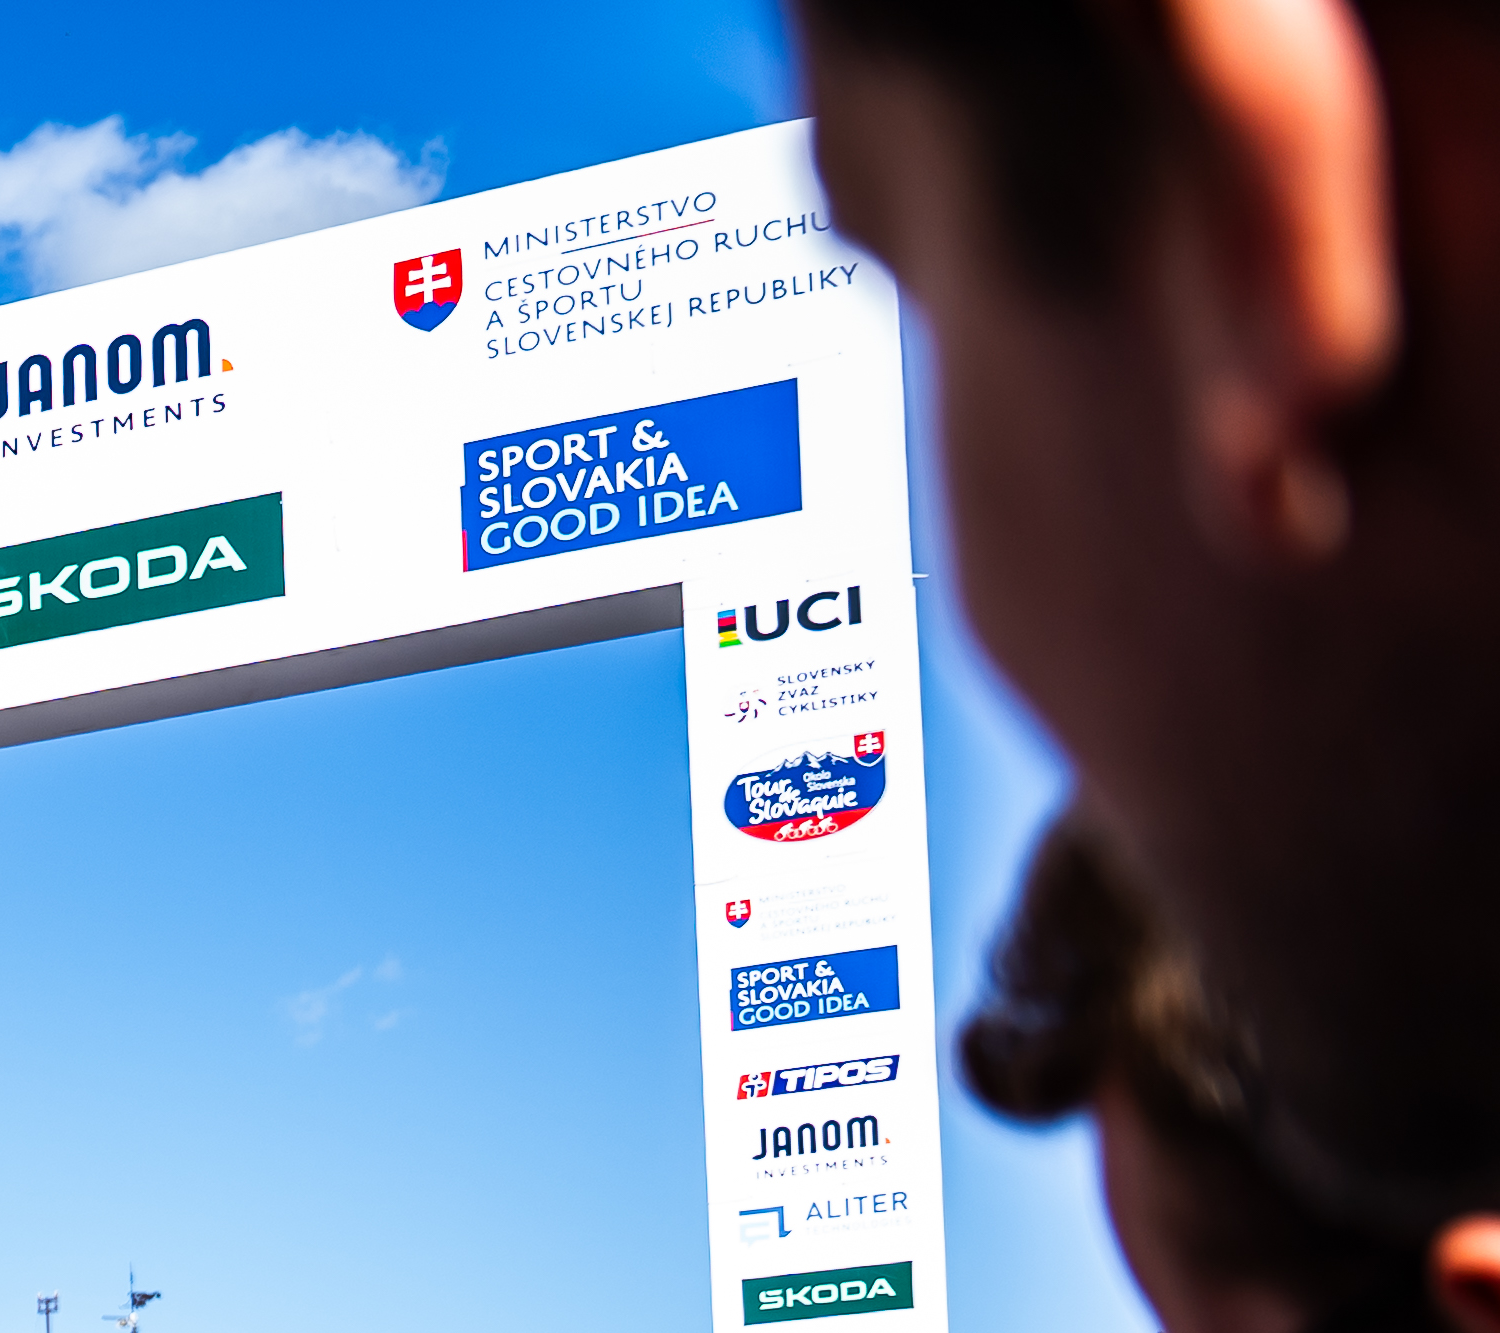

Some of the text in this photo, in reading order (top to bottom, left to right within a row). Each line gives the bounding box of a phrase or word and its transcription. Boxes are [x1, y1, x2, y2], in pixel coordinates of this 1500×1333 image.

[484, 191, 717, 260] MINISTERSTVO
[485, 212, 833, 302] CESTOVNÉHO RUCHU
[486, 279, 643, 331] A ŠPORTU
[486, 262, 860, 360] SLOVENSKEJ REPUBLIKY
[478, 418, 670, 484] SPORT &
[478, 453, 689, 520] SLOVAKIA
[479, 479, 741, 557] GOOD IDEA
[743, 584, 863, 642] UCI
[778, 691, 879, 716] CYKLISTIKY
[737, 775, 792, 802] Tour
[749, 787, 859, 825] Slovaquie
[737, 958, 836, 990] SPORT &
[737, 975, 845, 1008] SLOVAKIA
[738, 992, 871, 1026] GOOD IDEA
[779, 1057, 894, 1094] TIPOS
[752, 1114, 880, 1161] JANOM
[756, 1155, 889, 1180] INVESTMENTS
[805, 1190, 909, 1222] ALITER
